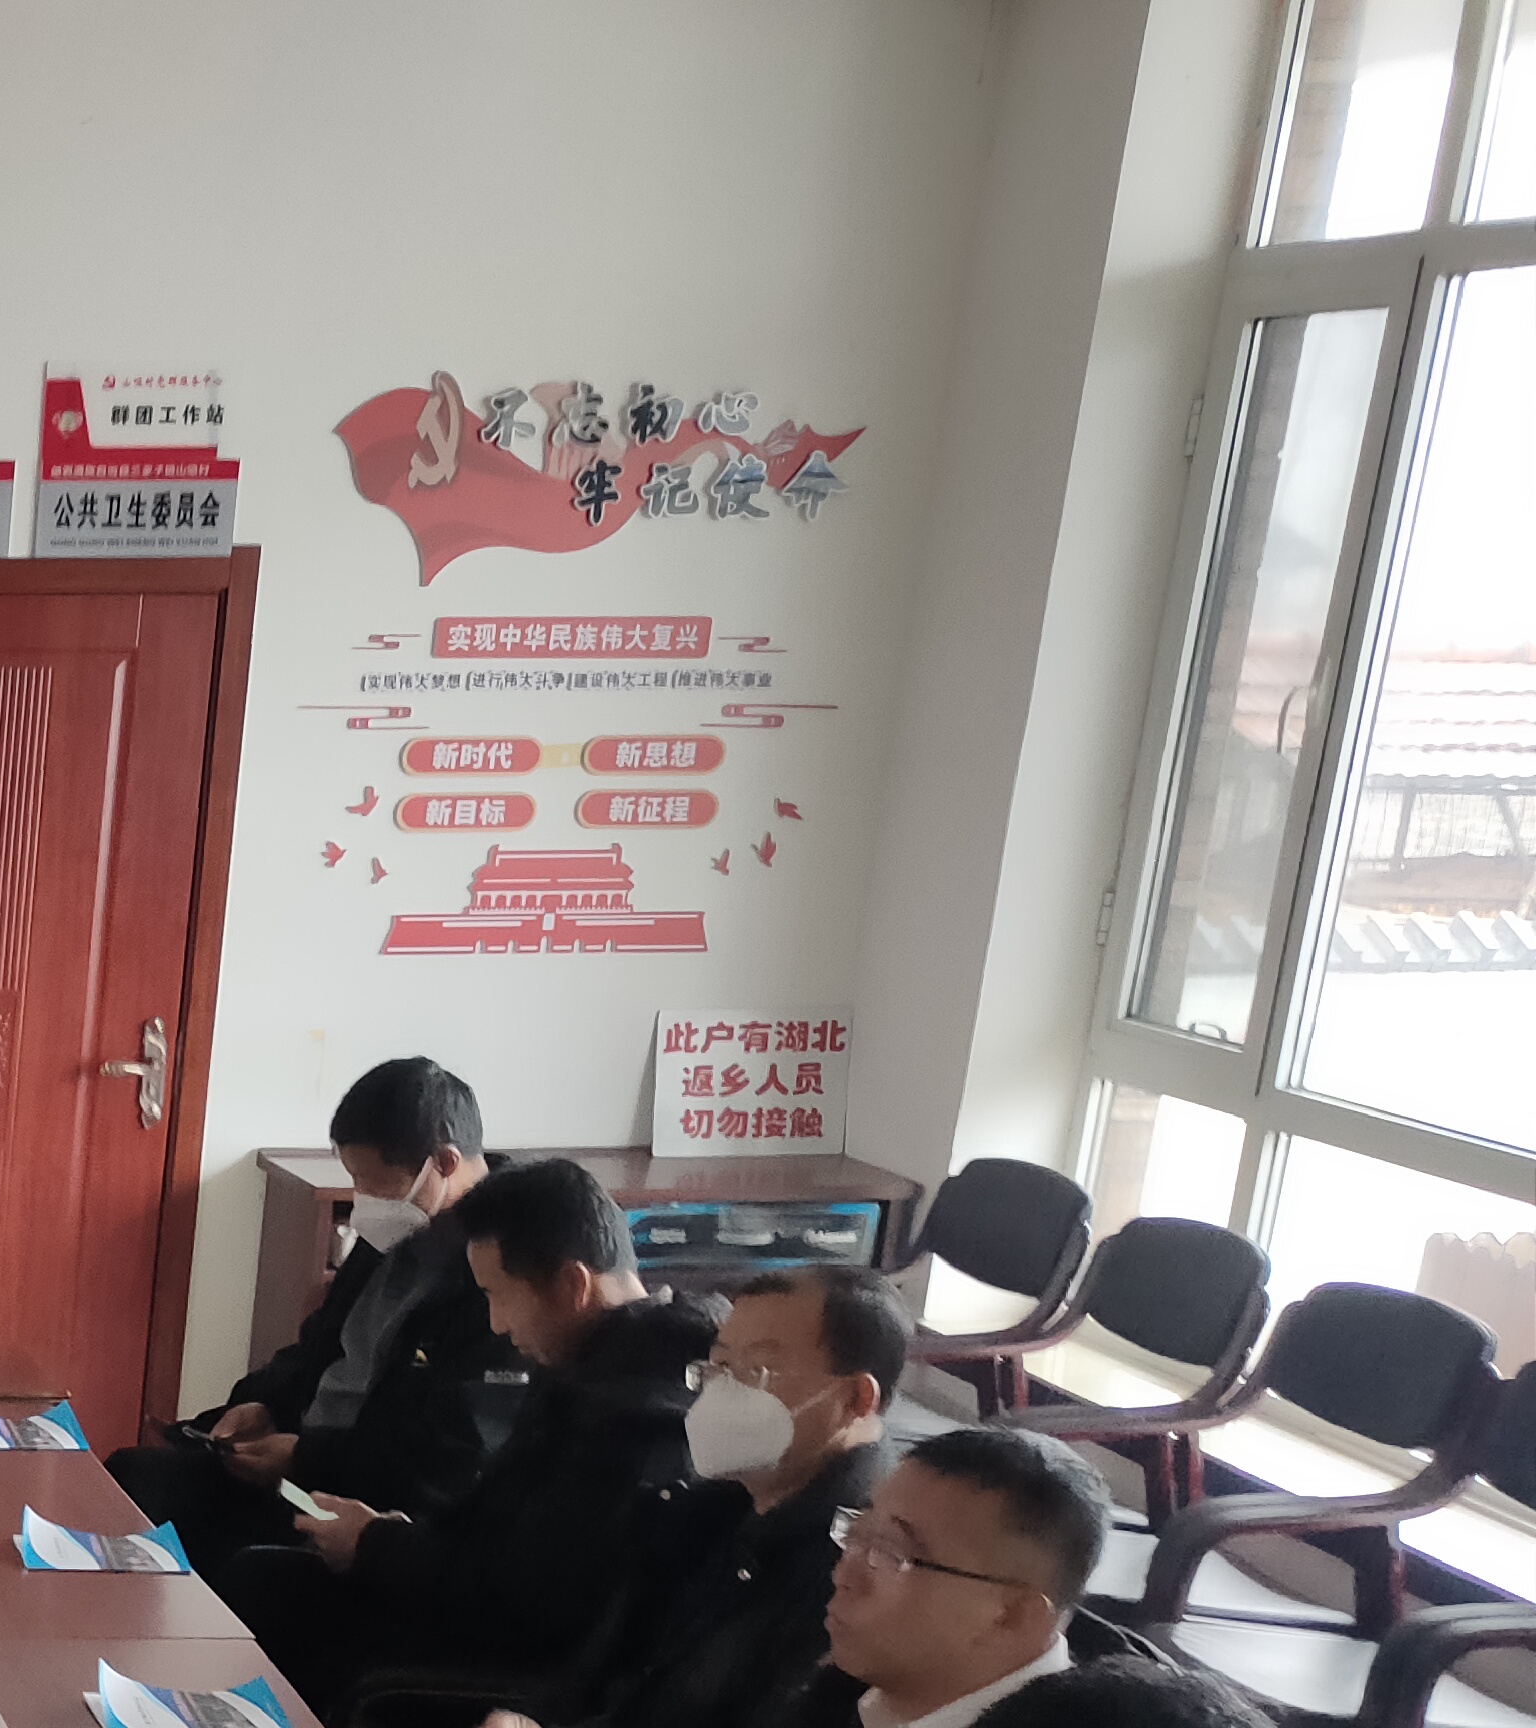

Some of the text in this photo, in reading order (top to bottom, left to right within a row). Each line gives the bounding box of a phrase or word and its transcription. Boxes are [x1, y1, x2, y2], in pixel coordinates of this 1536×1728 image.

[111, 403, 225, 426] 群团工作站
[480, 381, 759, 449] 不忘初心
[574, 451, 846, 526] 牢记使命
[53, 489, 222, 530] 公共卫生委员会
[446, 623, 700, 653] 实现中华民族伟大复兴
[472, 671, 565, 690] 进行伟大斗争
[432, 741, 515, 771] 新时代
[615, 740, 698, 769] 新思想
[424, 797, 507, 827] 新目标
[608, 795, 691, 824] 新征程
[662, 1019, 848, 1054] 此户有湖北
[681, 1062, 825, 1098] 返乡人员
[679, 1105, 825, 1140] 切勿接触
